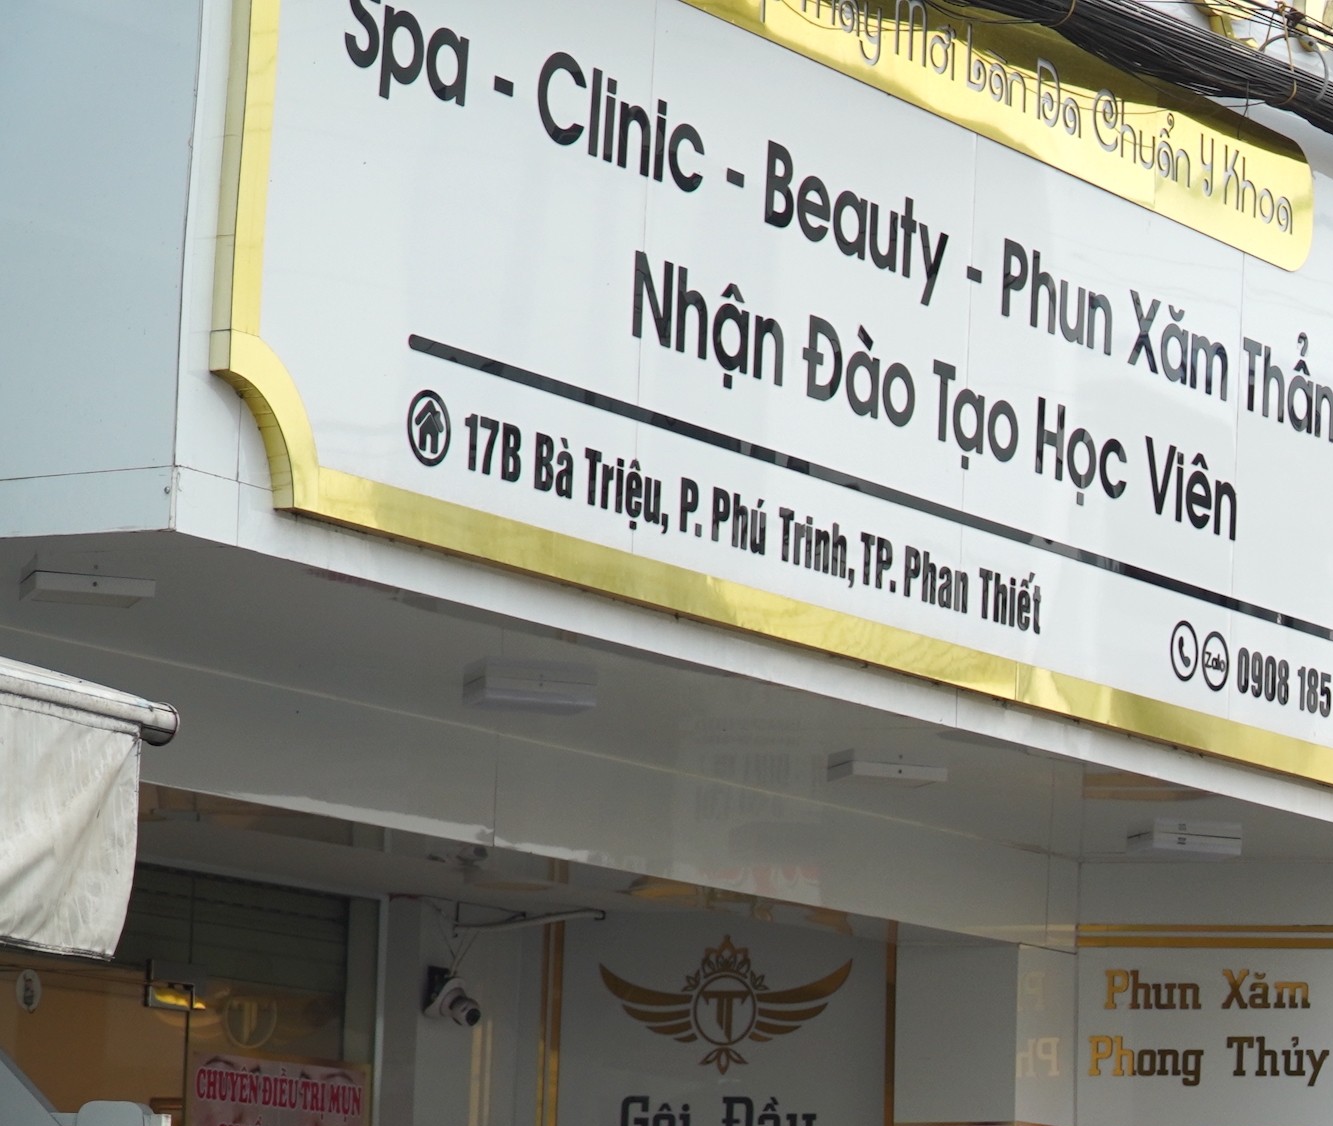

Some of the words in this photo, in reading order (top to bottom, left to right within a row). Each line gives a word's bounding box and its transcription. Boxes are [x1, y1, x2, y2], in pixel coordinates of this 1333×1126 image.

[344, 0, 469, 106] Spa
[537, 52, 704, 192] Clinic
[765, 140, 949, 306] Beauty
[1001, 238, 1111, 357] Phun
[1128, 289, 1228, 402] Xăm
[1222, 148, 1294, 236] Khoa
[632, 250, 785, 389] Nhận
[801, 314, 915, 428] Đào
[933, 360, 1019, 469] Tạo
[1036, 396, 1127, 505] Học
[1145, 436, 1236, 541] Viên
[464, 413, 522, 484] 17B
[533, 434, 574, 500] Bà
[584, 448, 669, 532] Triệu,
[679, 476, 702, 537] P.
[712, 486, 766, 556] Phú
[779, 507, 855, 589] Trinh,
[860, 532, 897, 593] TP.
[904, 545, 968, 614] Phan
[978, 568, 1042, 635] Thiết
[1237, 647, 1290, 705] 0908
[1297, 667, 1332, 719] 185
[1104, 969, 1202, 1010] Phun
[1221, 968, 1311, 1010] Xăm
[195, 1068, 260, 1106] CHUYÊN
[261, 1068, 300, 1110] ĐIỀU
[326, 1084, 363, 1123] MỤN
[1088, 1035, 1205, 1087] Phong
[1226, 1036, 1330, 1087] Thủy
